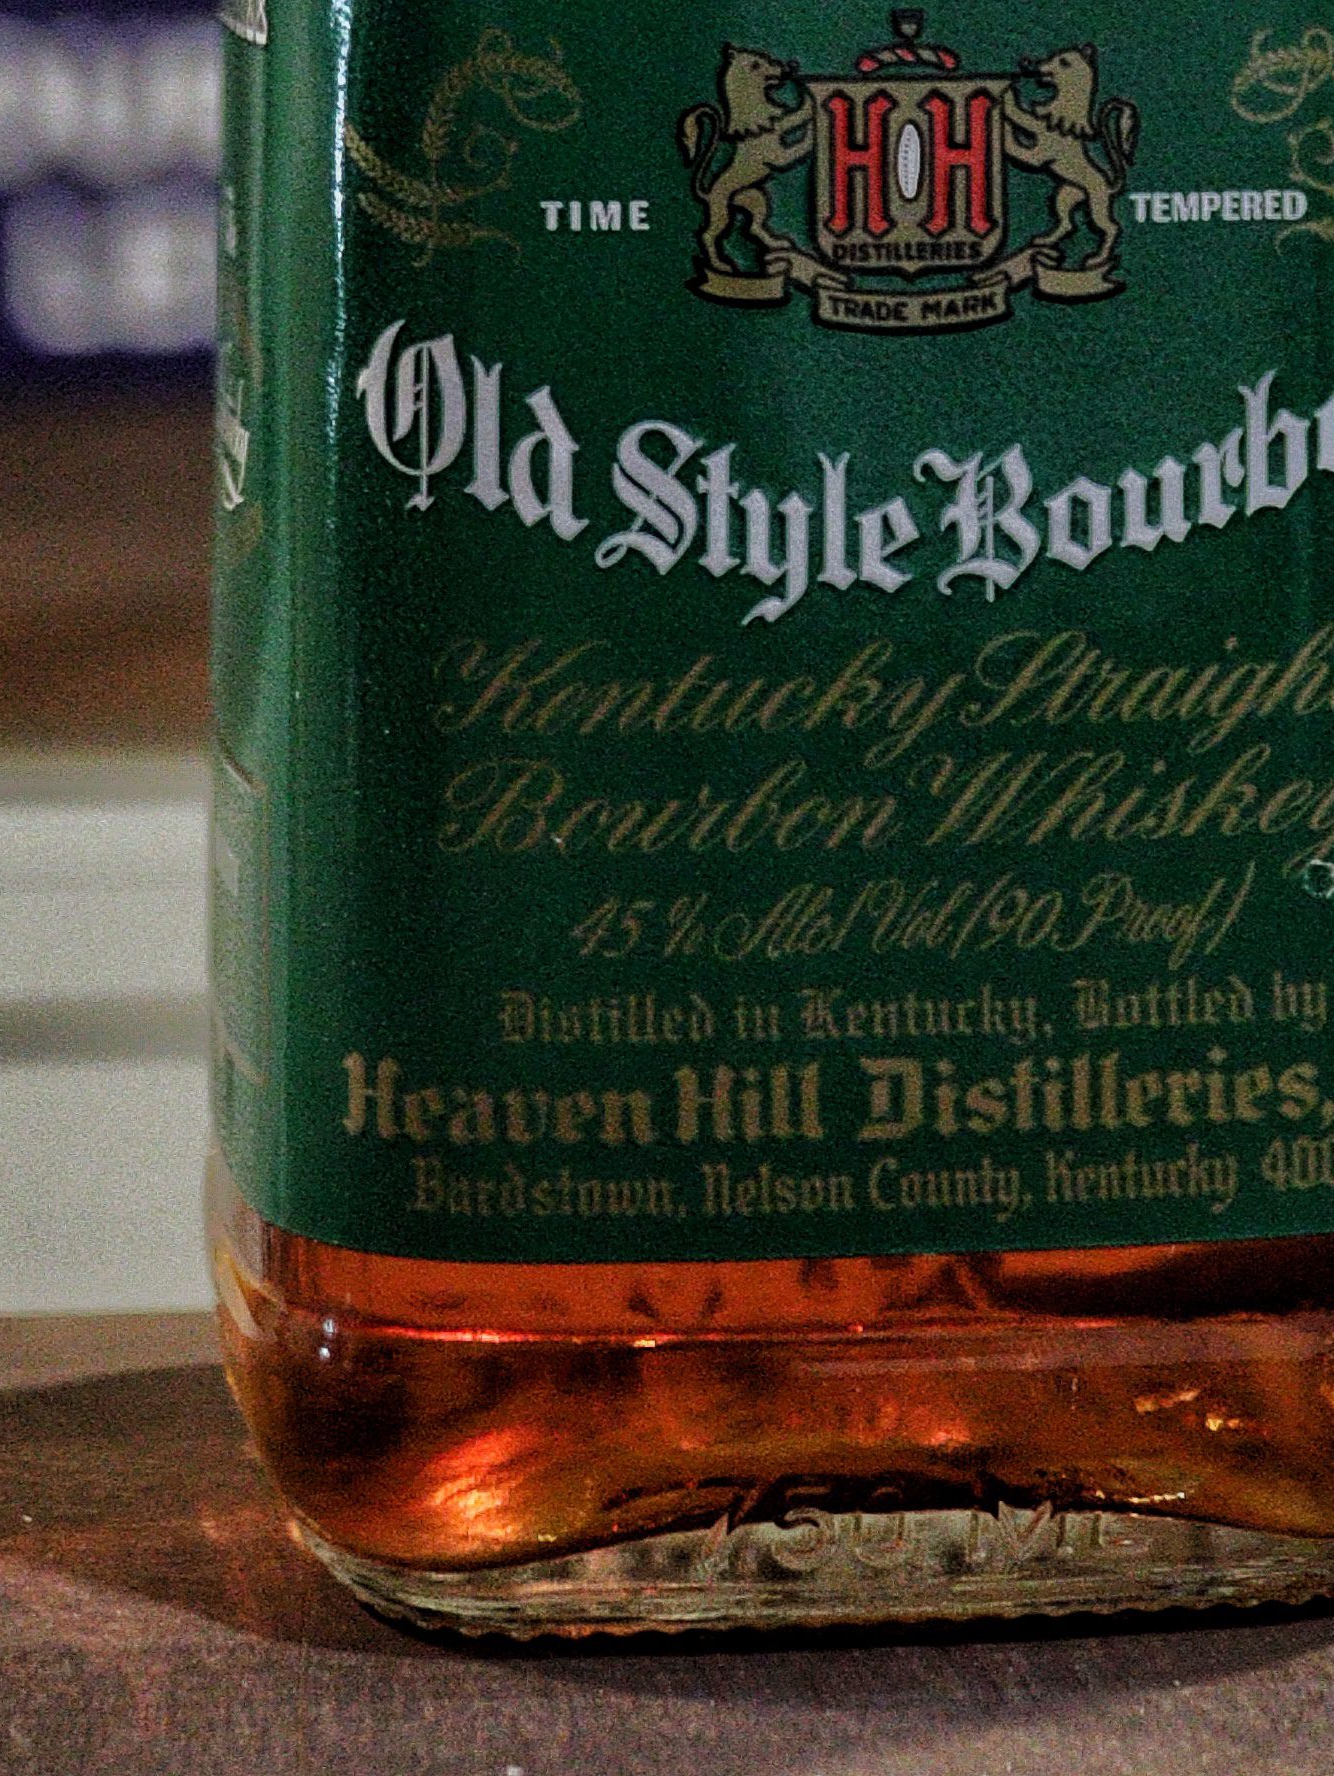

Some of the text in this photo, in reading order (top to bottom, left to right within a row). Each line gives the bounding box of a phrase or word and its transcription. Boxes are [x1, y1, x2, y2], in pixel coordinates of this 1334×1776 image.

[540, 200, 651, 231] TIME
[1129, 189, 1309, 223] TEMPERED
[832, 240, 984, 262] DISTILLERIES
[826, 292, 999, 322] TRADE MARK
[356, 319, 589, 542] Old
[594, 419, 921, 626] Style
[434, 638, 965, 768] Kentucky
[438, 756, 903, 850] Bourbon
[498, 989, 715, 1044] Distilled
[733, 995, 781, 1043] in
[1070, 974, 1255, 1029] Bottled
[1271, 971, 1328, 1032] by
[341, 1050, 657, 1146] Heaven
[673, 1061, 825, 1144] Hill
[701, 1160, 855, 1216] Nelson
[1044, 1142, 1238, 1214] Kentucky
